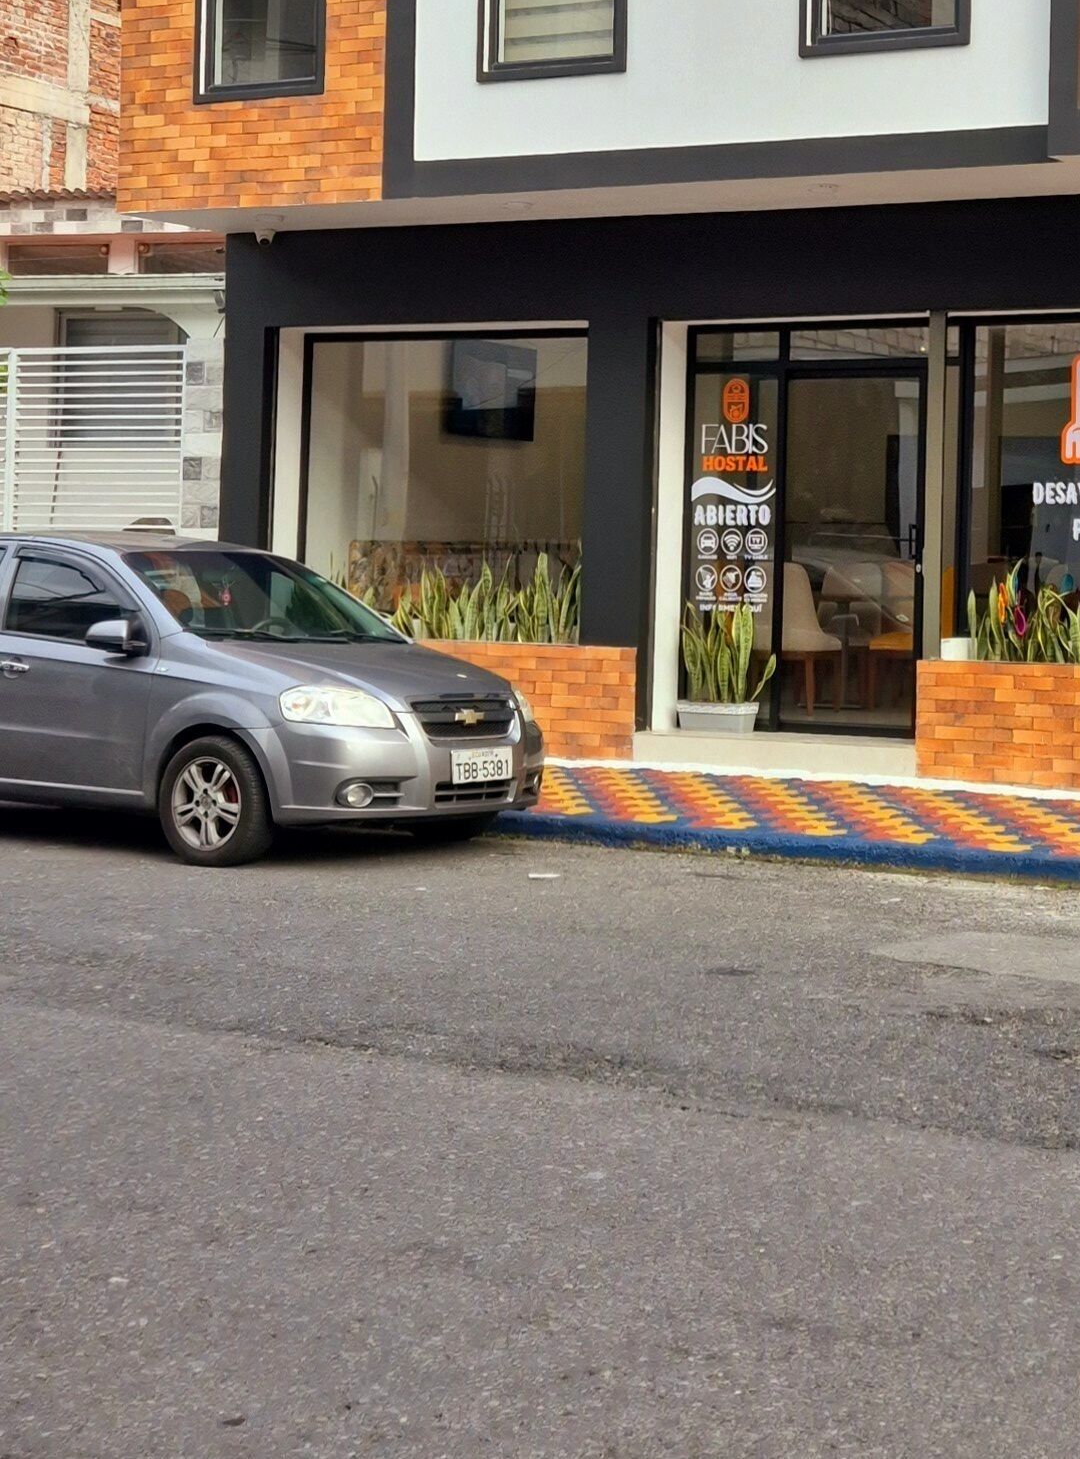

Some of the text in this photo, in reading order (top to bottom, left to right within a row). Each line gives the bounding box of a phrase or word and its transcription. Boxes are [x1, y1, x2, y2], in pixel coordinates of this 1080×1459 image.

[701, 424, 769, 454] FABIS
[702, 455, 769, 472] HOSTAL
[694, 504, 772, 526] ABIERTO
[455, 759, 509, 781] TBB-5381
